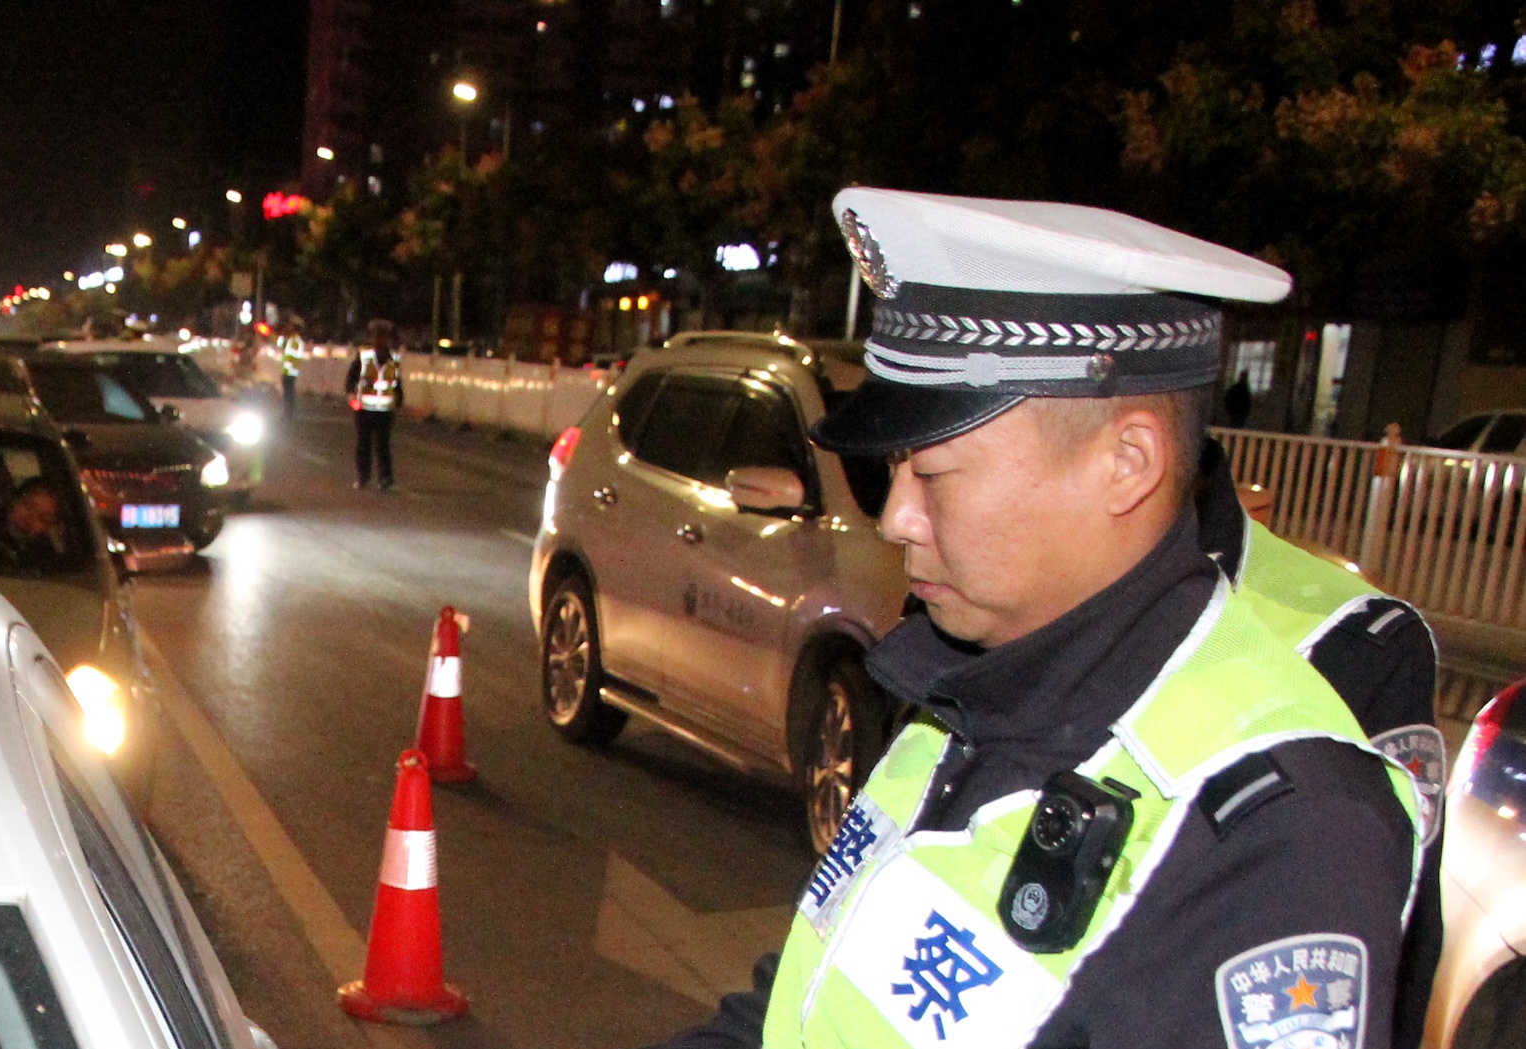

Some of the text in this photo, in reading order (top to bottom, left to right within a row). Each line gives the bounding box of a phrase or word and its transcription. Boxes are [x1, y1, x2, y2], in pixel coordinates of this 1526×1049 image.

[891, 908, 1005, 1041] 察
[1229, 946, 1359, 994] 中华人民共和国
[1240, 991, 1275, 1024] 警
